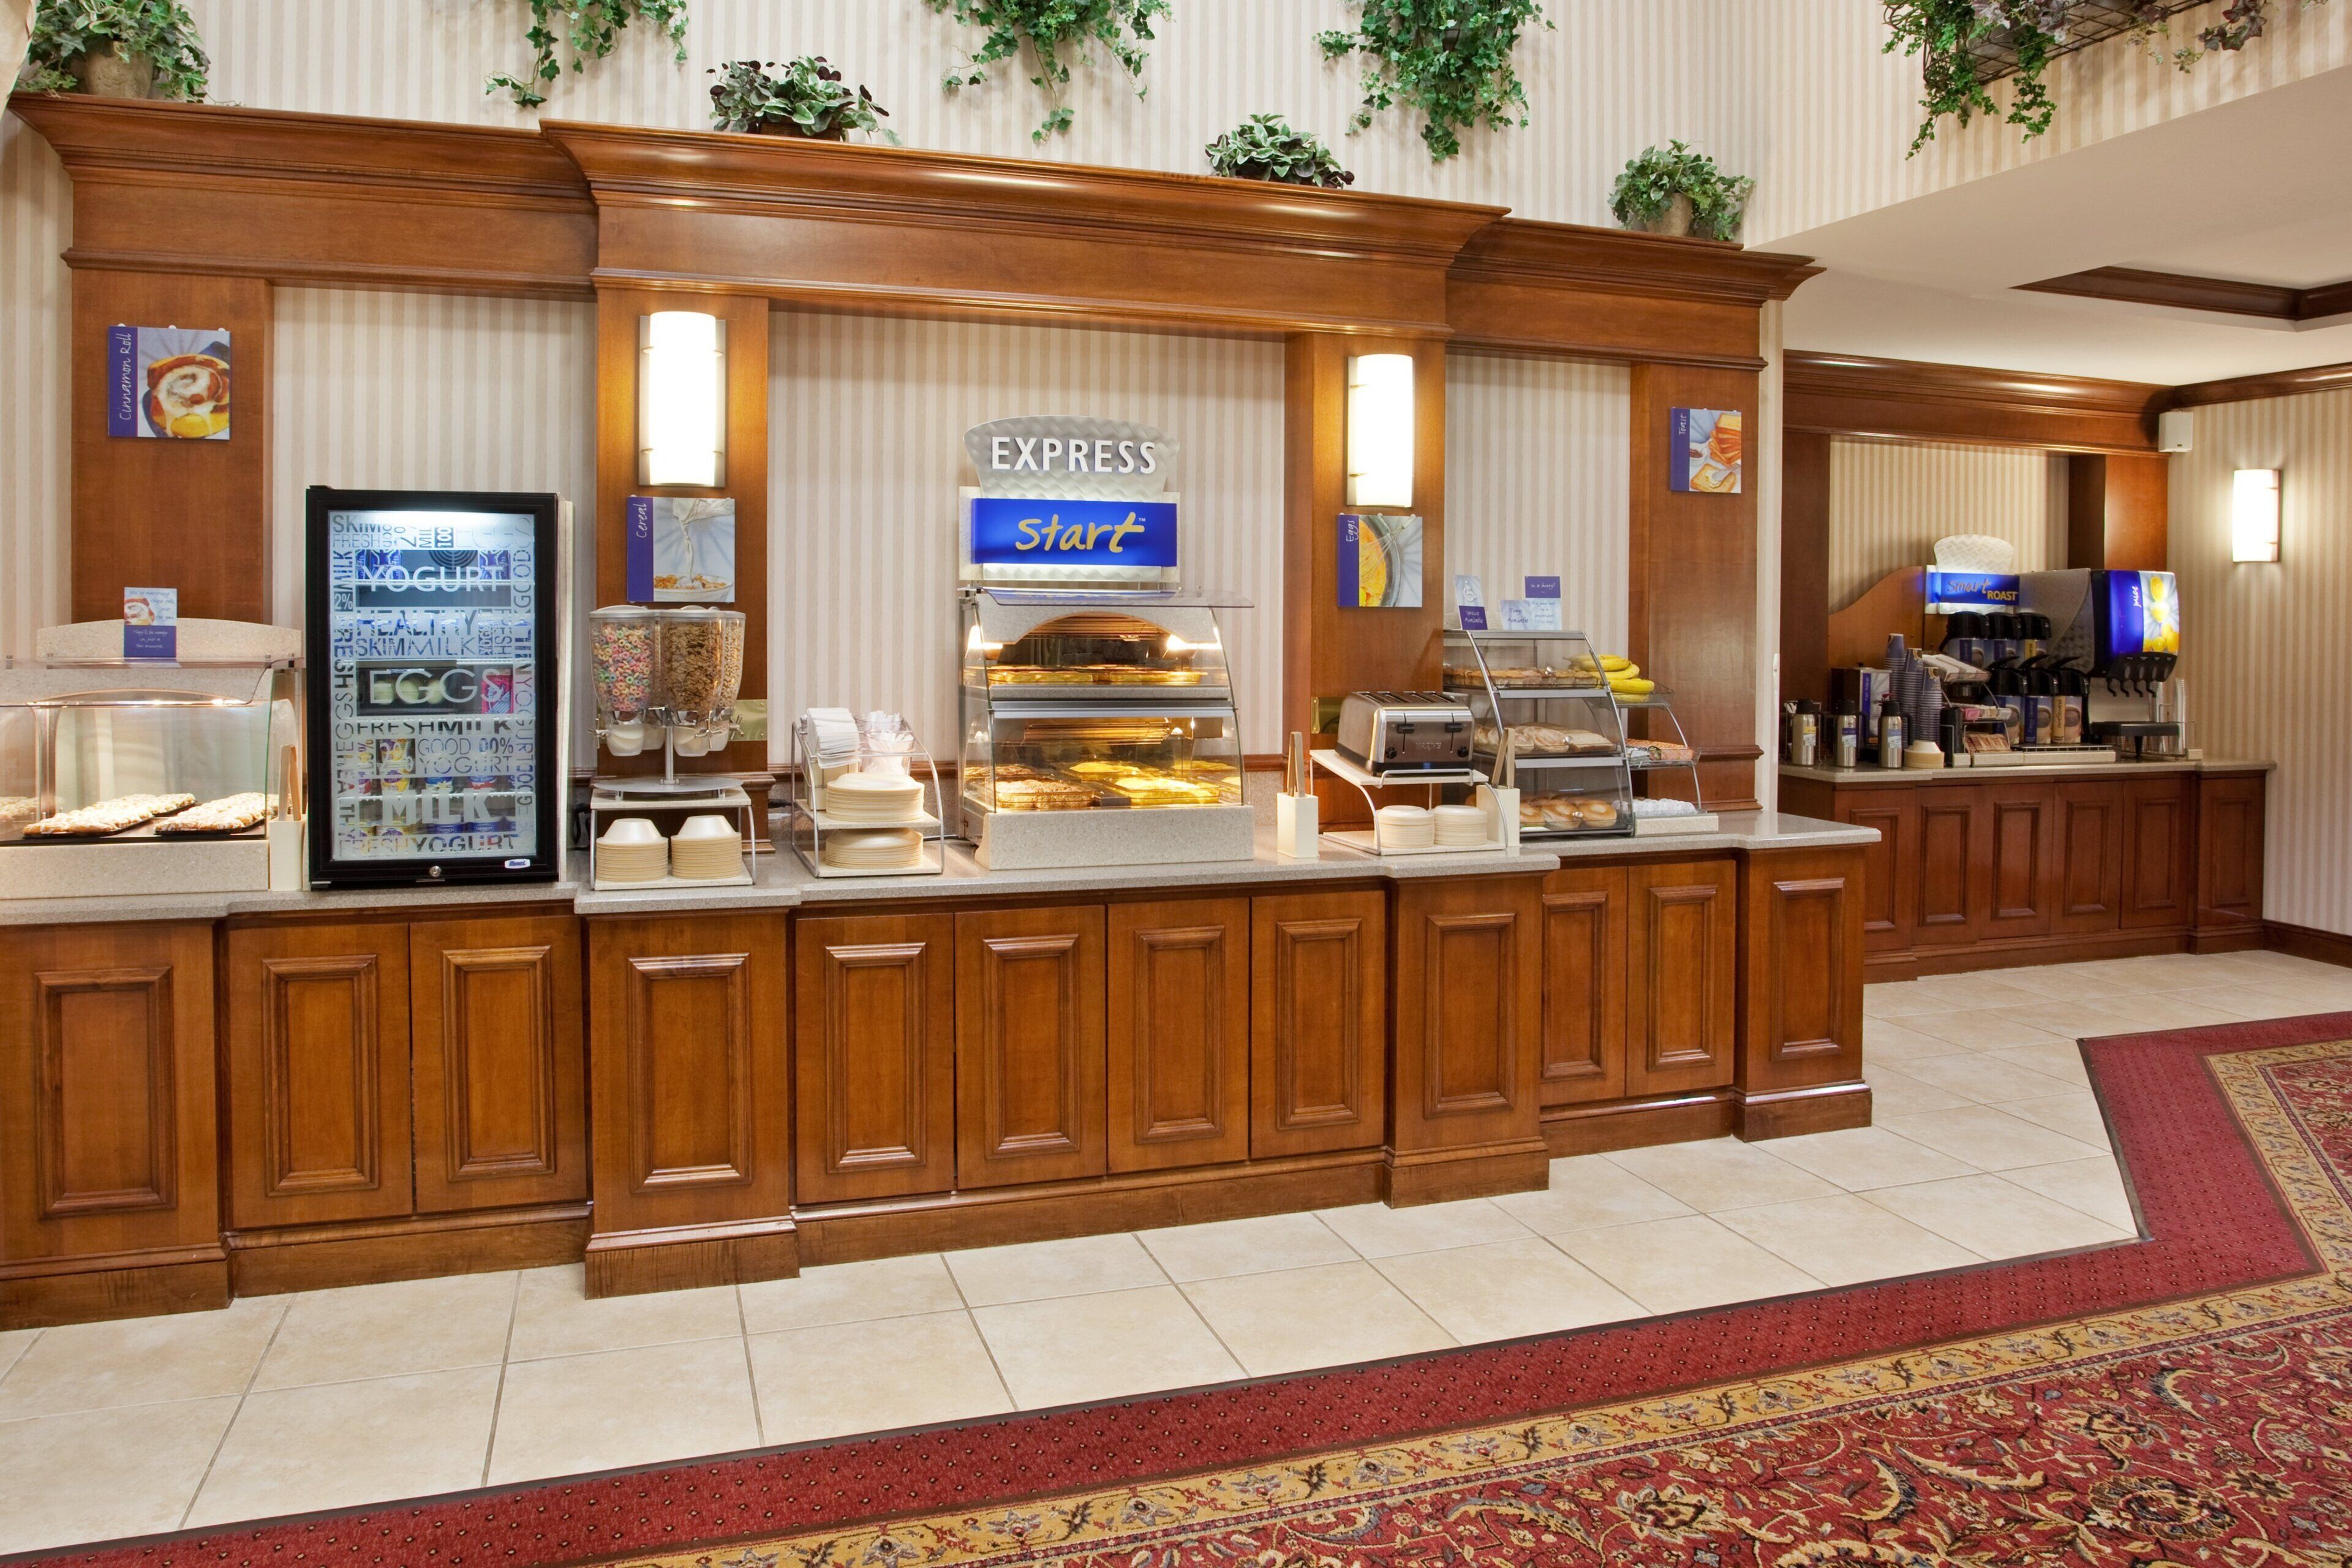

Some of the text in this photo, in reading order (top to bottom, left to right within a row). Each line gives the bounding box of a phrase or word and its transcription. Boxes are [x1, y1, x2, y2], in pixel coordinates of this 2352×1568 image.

[116, 333, 132, 421] Cinnamon Roll
[992, 436, 1156, 474] EXPRESS
[633, 503, 647, 538] Cereal
[1015, 511, 1145, 553] Start
[1346, 520, 1359, 542] Eggs
[333, 533, 380, 548] FRESH
[362, 565, 505, 592] YOGURT
[513, 549, 532, 608] GOOD
[1948, 578, 1991, 594] Smart
[334, 592, 353, 610] 2%
[1987, 590, 2019, 601] ROAST
[2132, 586, 2142, 608] juice
[356, 609, 477, 636] HEALTHY
[369, 668, 504, 704] EGGS
[335, 693, 354, 752] EGGS
[418, 737, 471, 756] GOOD
[419, 755, 513, 775] YOGURT
[383, 789, 494, 824] MILK
